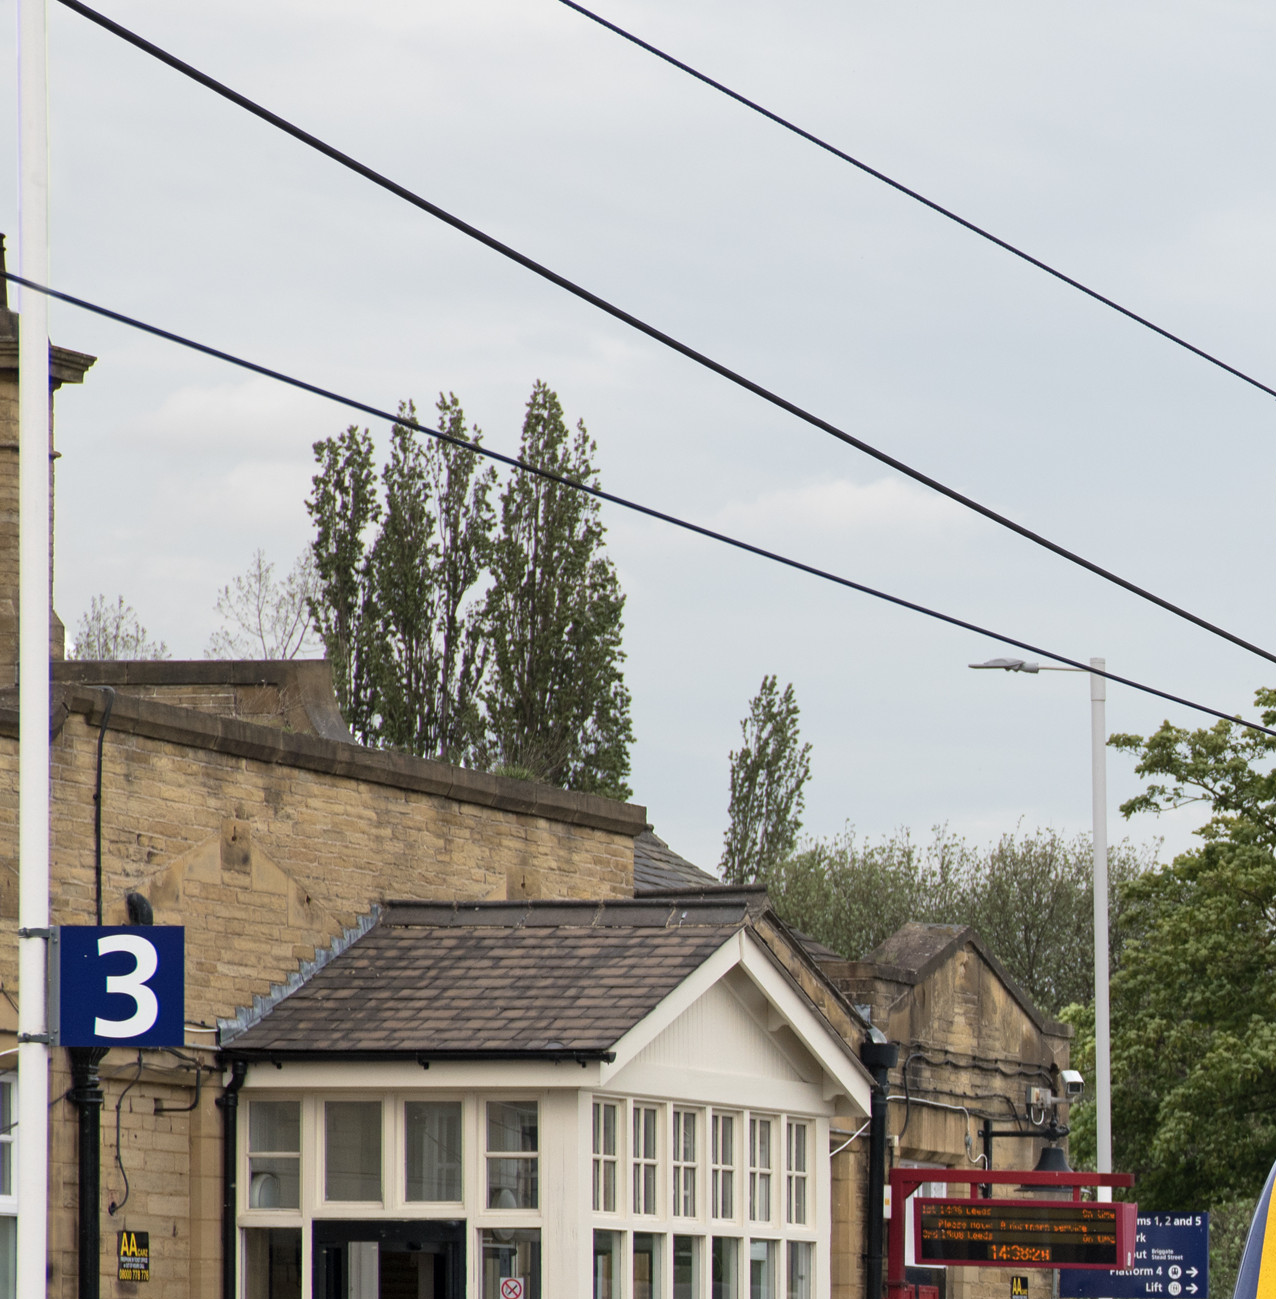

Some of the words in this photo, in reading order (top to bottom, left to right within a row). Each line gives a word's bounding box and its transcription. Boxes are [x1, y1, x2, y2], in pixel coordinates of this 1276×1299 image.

[94, 934, 158, 1038] 3
[1154, 1217, 1163, 1227] 1,
[1165, 1217, 1172, 1226] 2
[1173, 1216, 1193, 1226] and
[1195, 1216, 1202, 1226] 5
[120, 1232, 138, 1256] AA
[1151, 1248, 1174, 1256] Briggate
[1110, 1267, 1154, 1276] Platform
[1155, 1267, 1163, 1276] 4
[1145, 1282, 1163, 1293] Lift
